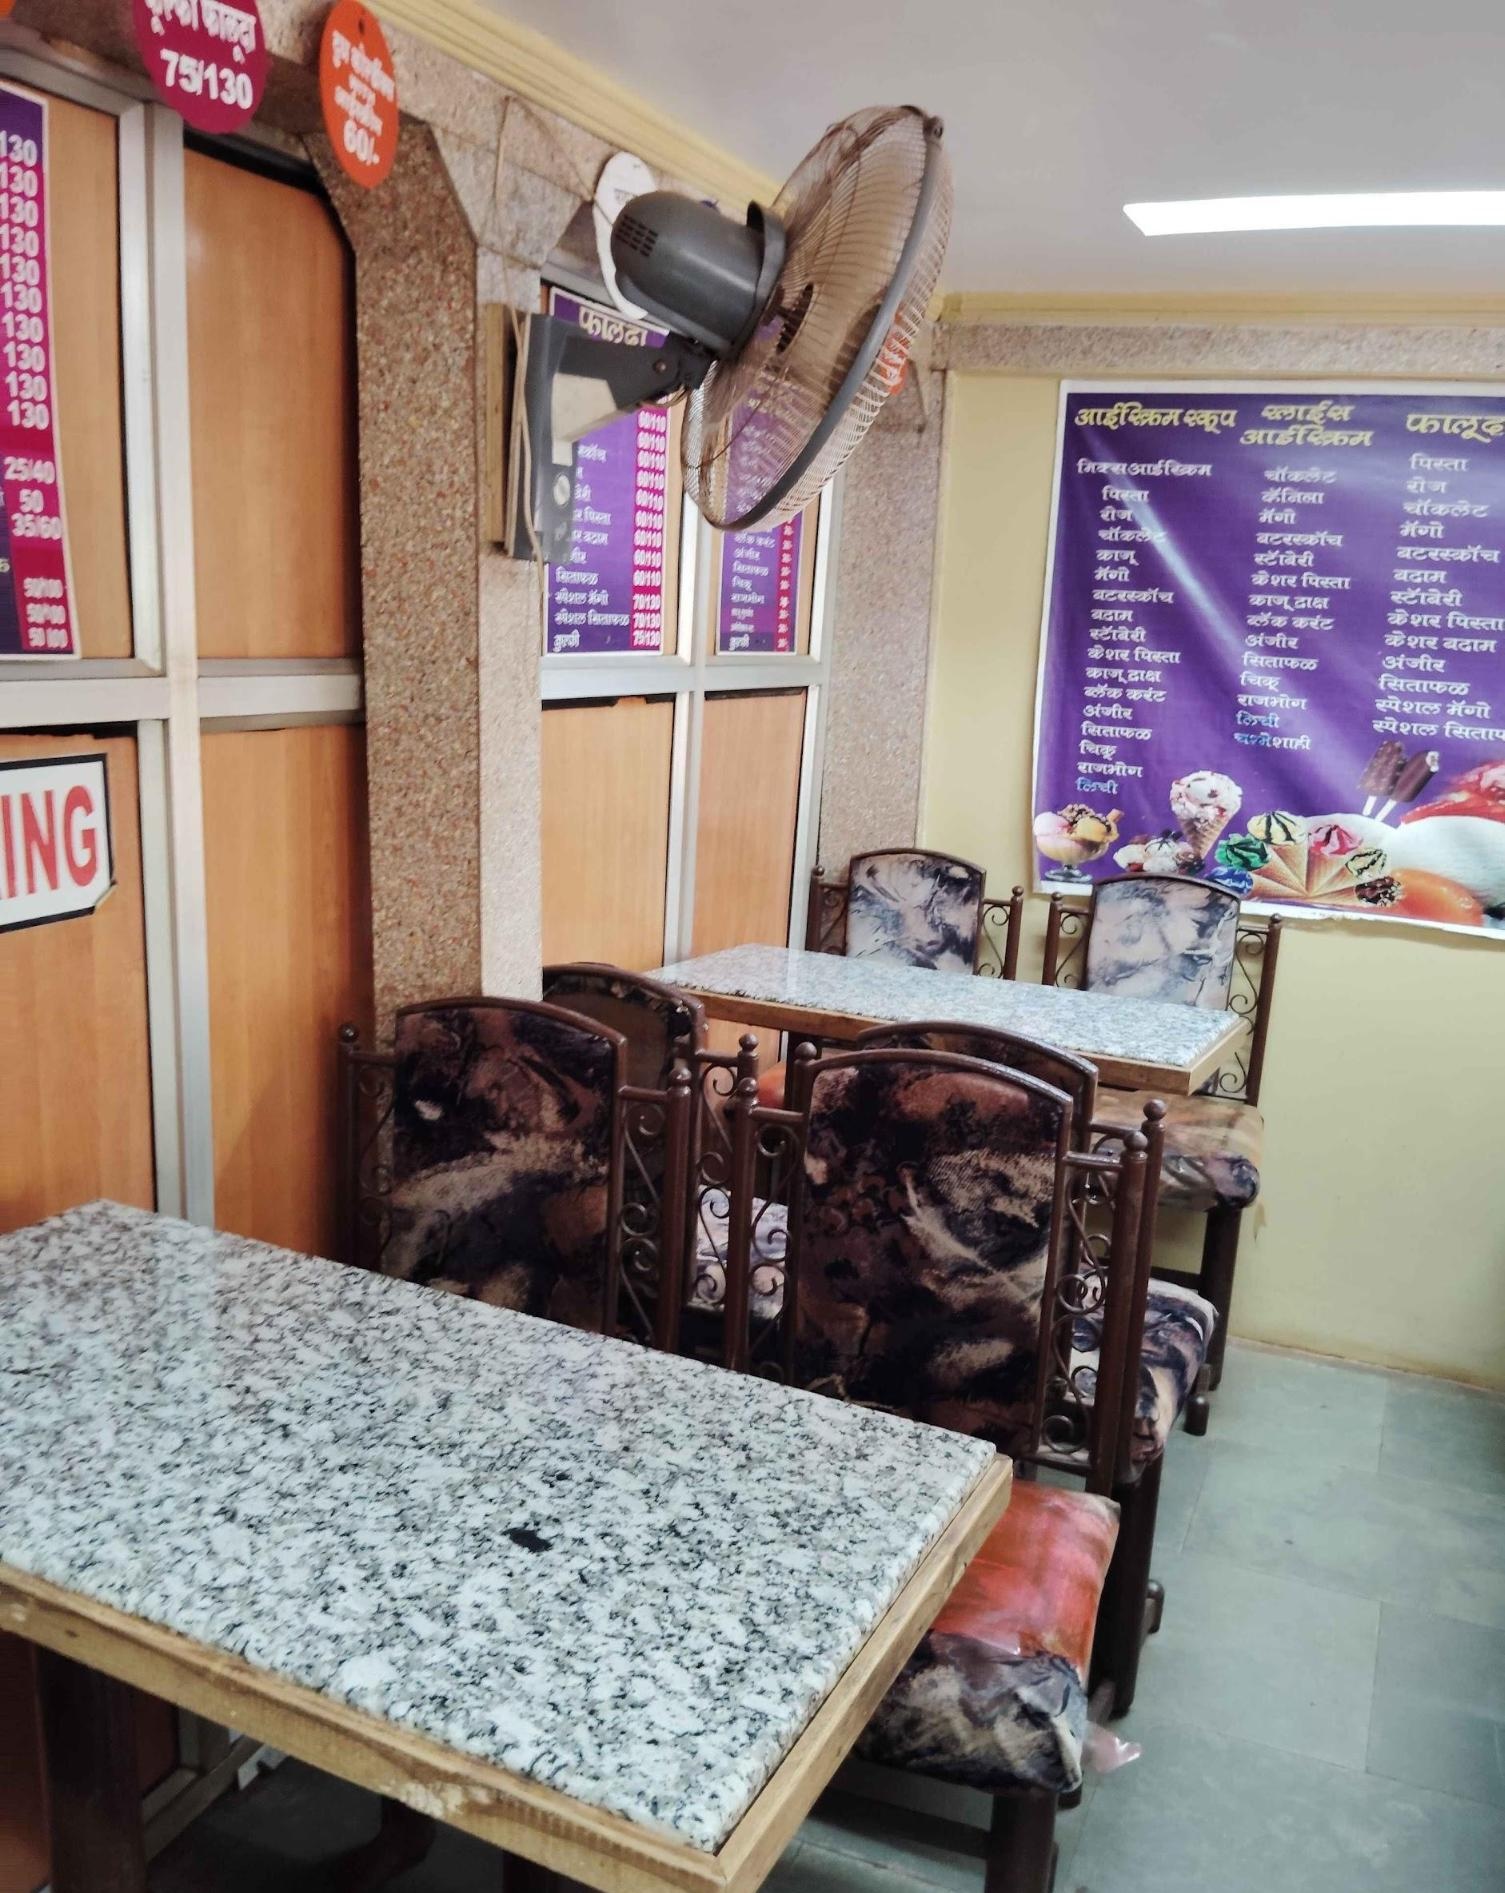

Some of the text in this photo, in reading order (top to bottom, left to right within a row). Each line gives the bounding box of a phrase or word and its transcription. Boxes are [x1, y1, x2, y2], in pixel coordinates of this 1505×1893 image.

[160, 48, 253, 110] 75/130
[579, 306, 648, 346] फालदा
[1184, 408, 1238, 434] स्कूप
[1409, 452, 1469, 472] पिस्ता
[1264, 465, 1337, 484] चॉकलेट
[1102, 485, 1149, 501] पिस्ता
[1406, 477, 1447, 494] रोज
[1100, 506, 1133, 522] रोज
[1402, 499, 1490, 518] चॉकलेट
[1098, 526, 1167, 543] चॉकलेट
[1096, 549, 1139, 566] काजू
[1397, 545, 1500, 563] बटरस्कॉच
[1251, 570, 1351, 589] केशर पिस्ता
[1393, 568, 1447, 584] बदाम
[1249, 594, 1294, 611] काजू
[1091, 609, 1133, 622] बदाम
[1292, 615, 1335, 631] करंट
[1387, 609, 1505, 631] केशर पिस्ता
[1245, 633, 1299, 649] अंजीर
[1384, 630, 1497, 653] केशर बदाम
[1088, 644, 1181, 663] केशर पिस्ता
[1243, 651, 1319, 671] सिताफळ
[1382, 654, 1446, 672] अंजीर
[1085, 667, 1127, 684] काजू
[1240, 671, 1280, 691] चिकू
[1378, 673, 1470, 696] सिताफळ
[1126, 687, 1167, 702] करंट
[1237, 693, 1307, 710] राजभोग
[1083, 703, 1133, 720] अंजीर
[1375, 697, 1442, 716] स्पेशल
[1081, 720, 1152, 740] सिताफळ
[1373, 717, 1439, 736] स्पेशल
[1079, 739, 1117, 760] चिकू
[1077, 761, 1143, 777] राजभोग
[0, 785, 98, 898] ING
